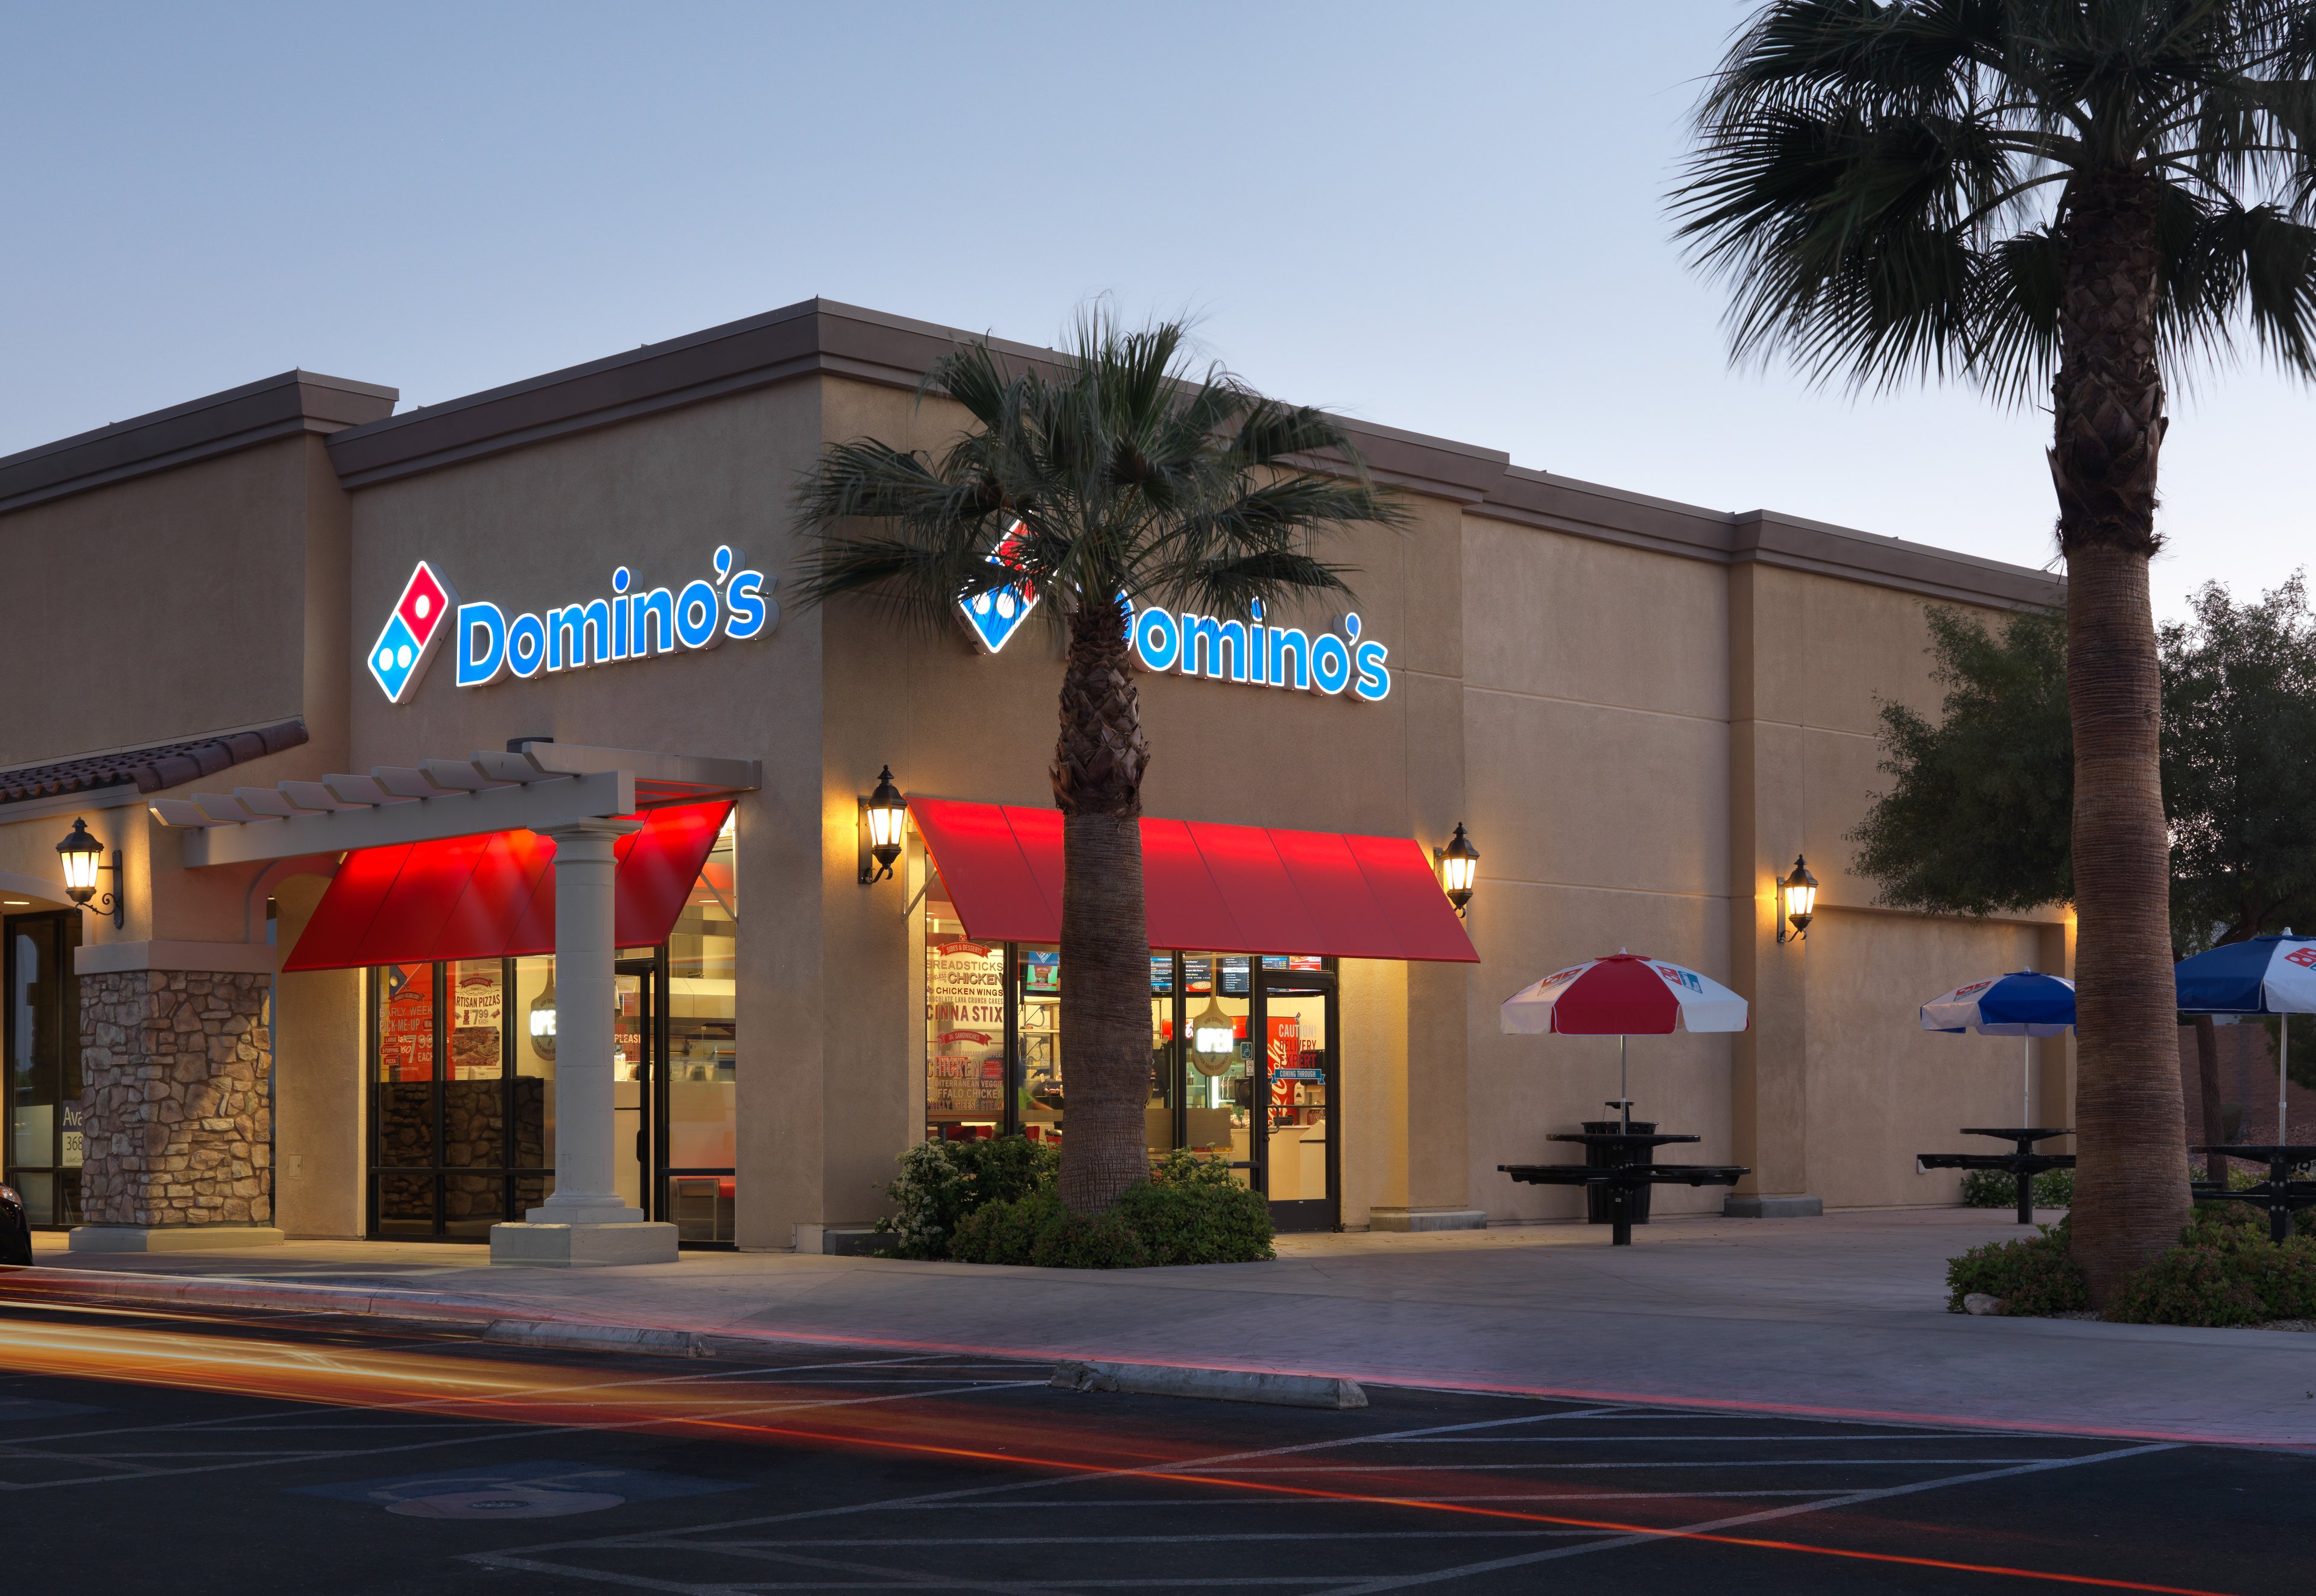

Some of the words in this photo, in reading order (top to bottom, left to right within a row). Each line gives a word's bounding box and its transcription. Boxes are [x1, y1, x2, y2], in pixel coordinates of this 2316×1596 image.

[457, 545, 772, 687] Domino's
[1118, 589, 1391, 701] omino's
[963, 945, 982, 954] DESSERTS
[927, 960, 1004, 971] BREADSTICKS
[948, 971, 1004, 985] CHICKEN
[479, 994, 500, 1007] PIZZAS
[379, 1006, 406, 1017] EARLY
[410, 1005, 432, 1016] WEEK
[927, 1005, 969, 1021] CINNA
[972, 1006, 1003, 1023] STIX
[380, 1018, 420, 1033] PICK-ME-UP
[1279, 1024, 1317, 1038] CAUTION!
[955, 1032, 979, 1041] SANDWICHES
[1197, 1027, 1233, 1053] OPEN
[1279, 1039, 1317, 1052] DELIVERY
[1279, 1054, 1317, 1067] EXPERT
[928, 1059, 980, 1078] CHICKEN
[927, 1088, 964, 1098] BUFFALO
[967, 1089, 1004, 1099] CHICKEN
[927, 1100, 951, 1109] PHILLY
[953, 1100, 978, 1109] CHEESE
[981, 1100, 1004, 1110] STEAK
